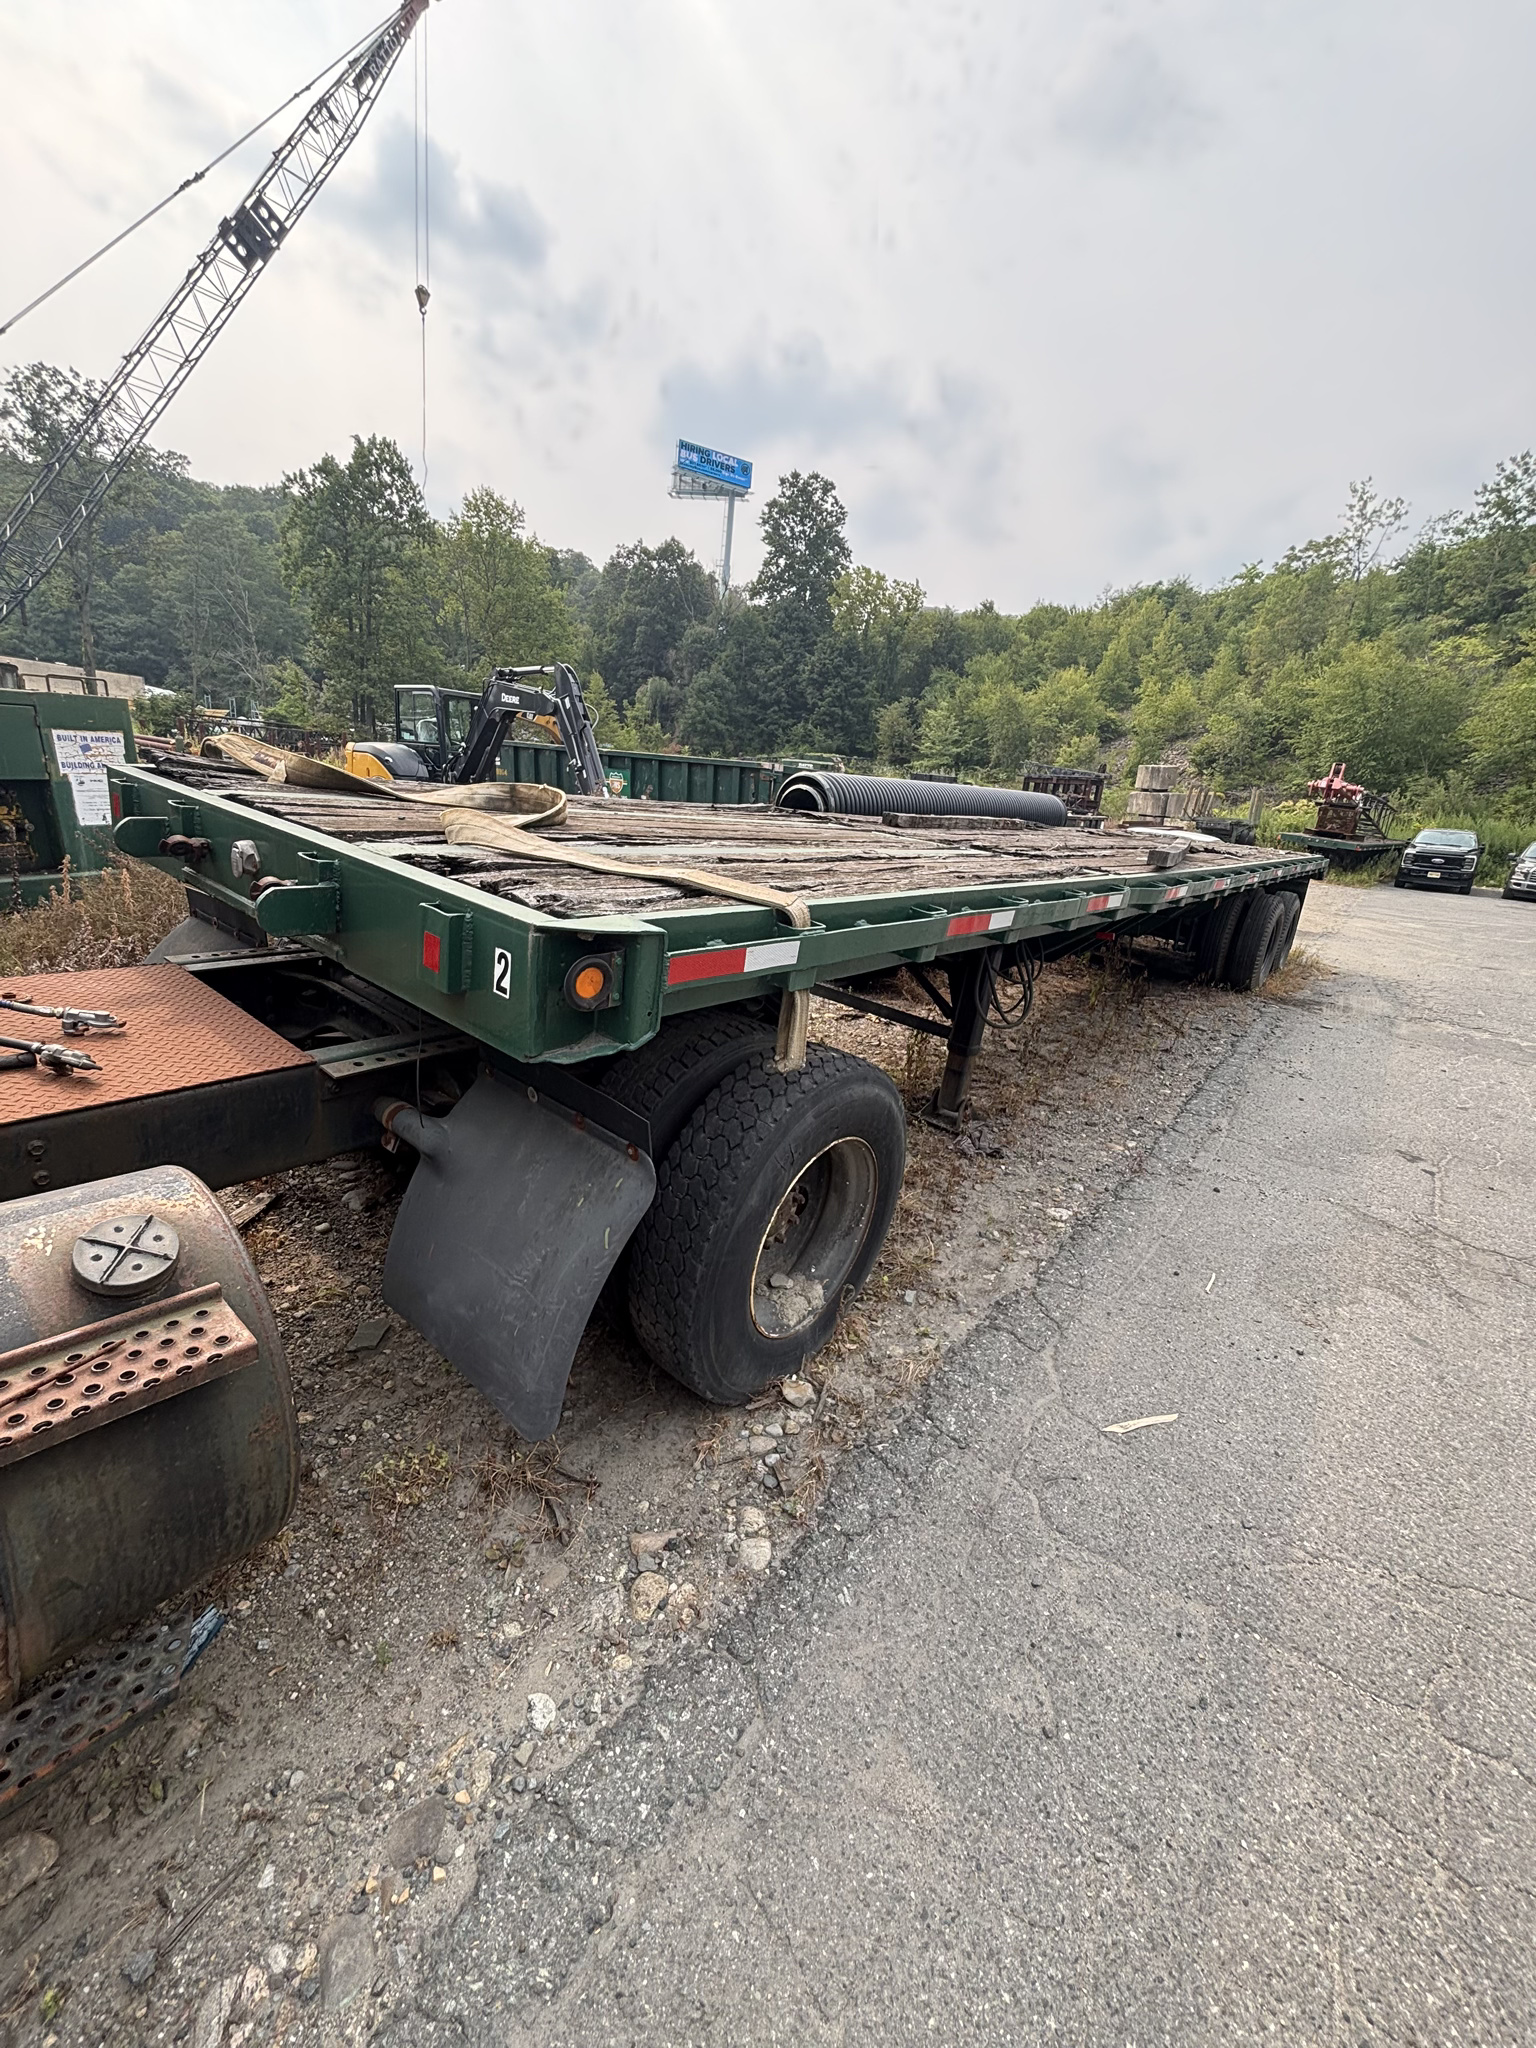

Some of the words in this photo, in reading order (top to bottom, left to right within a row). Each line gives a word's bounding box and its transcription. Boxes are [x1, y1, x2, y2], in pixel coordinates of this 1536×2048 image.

[680, 441, 711, 457] HIRING
[712, 451, 739, 467] LOCAL
[680, 449, 699, 462] BUS
[700, 456, 736, 474] DRIVERS
[501, 692, 520, 705] DEERE
[56, 734, 78, 742] BUILT
[90, 735, 122, 744] AMERICA
[60, 761, 95, 770] BUILDING
[495, 951, 510, 996] 2
